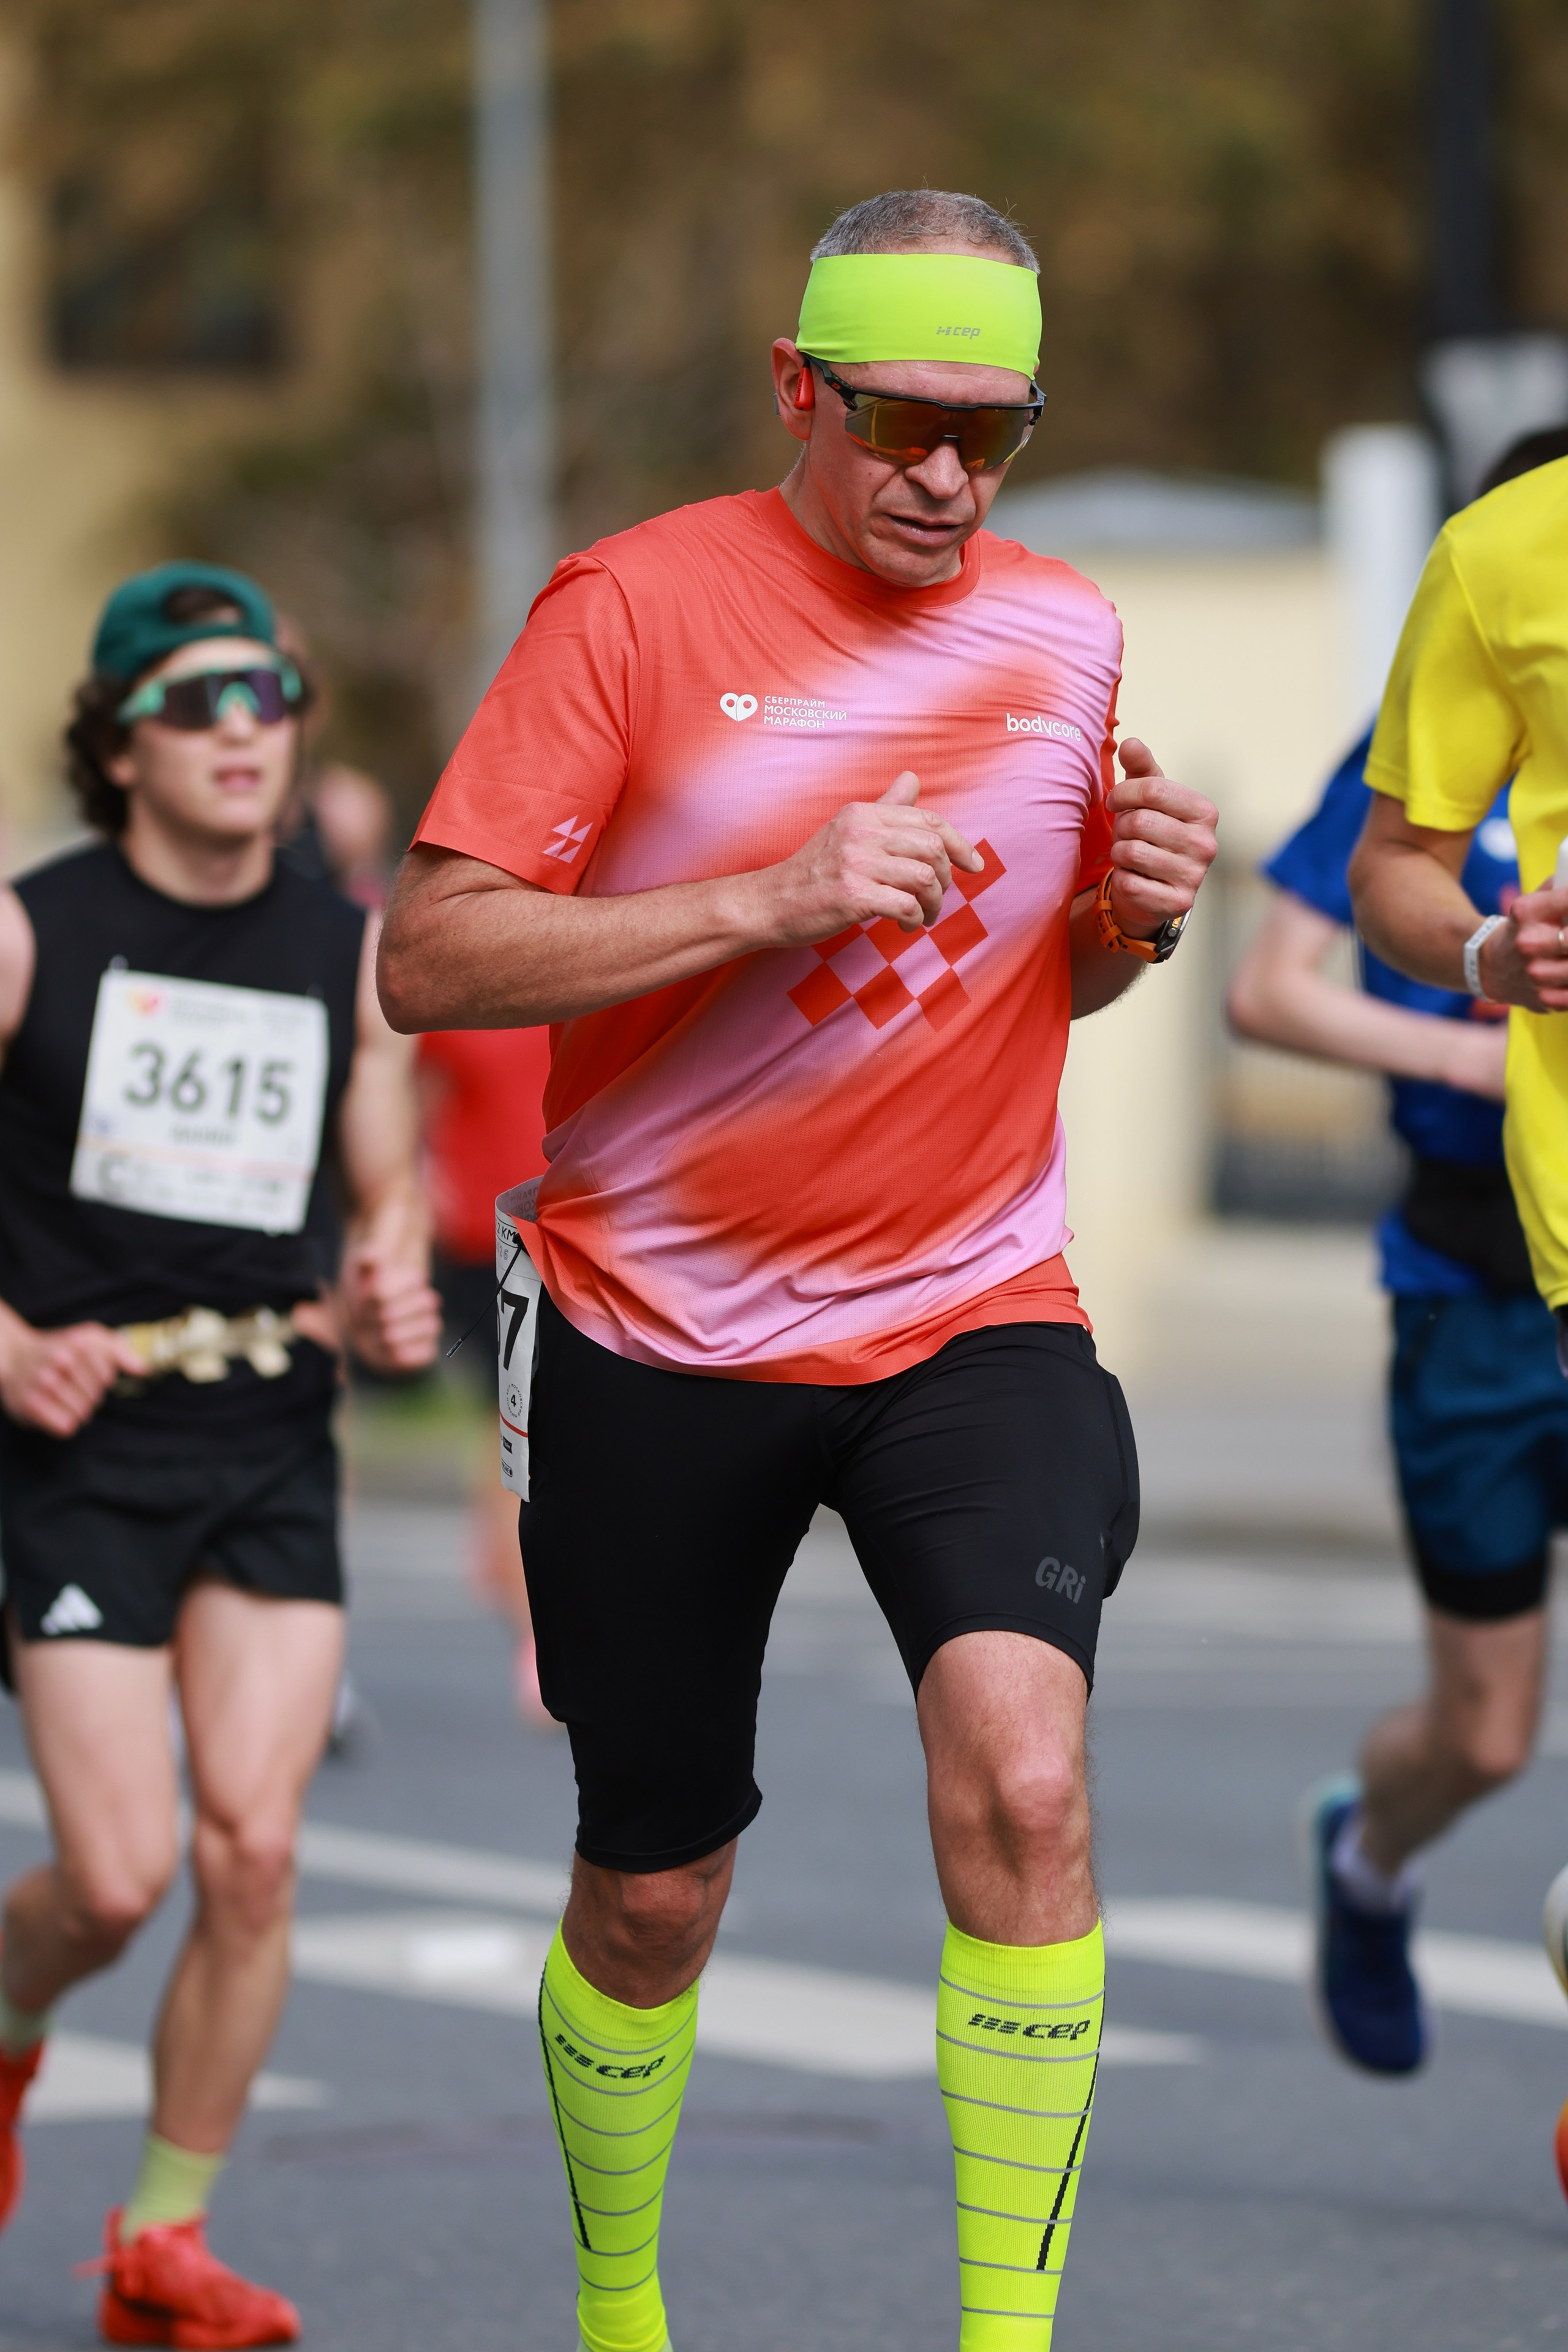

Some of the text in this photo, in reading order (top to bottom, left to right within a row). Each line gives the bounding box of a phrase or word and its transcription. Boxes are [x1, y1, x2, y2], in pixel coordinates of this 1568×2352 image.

[952, 326, 981, 340] cep
[764, 695, 826, 708] СБЕРПРАЙМ
[763, 715, 826, 729] МАРАФОН
[764, 705, 847, 721] МОСКОВСКИЙ
[1006, 712, 1081, 742] bodycore
[123, 1042, 295, 1126] 3615
[497, 1286, 530, 1372] 7
[510, 1393, 517, 1408] 4
[1022, 2019, 1090, 2040] cep
[596, 2055, 666, 2079] cep
